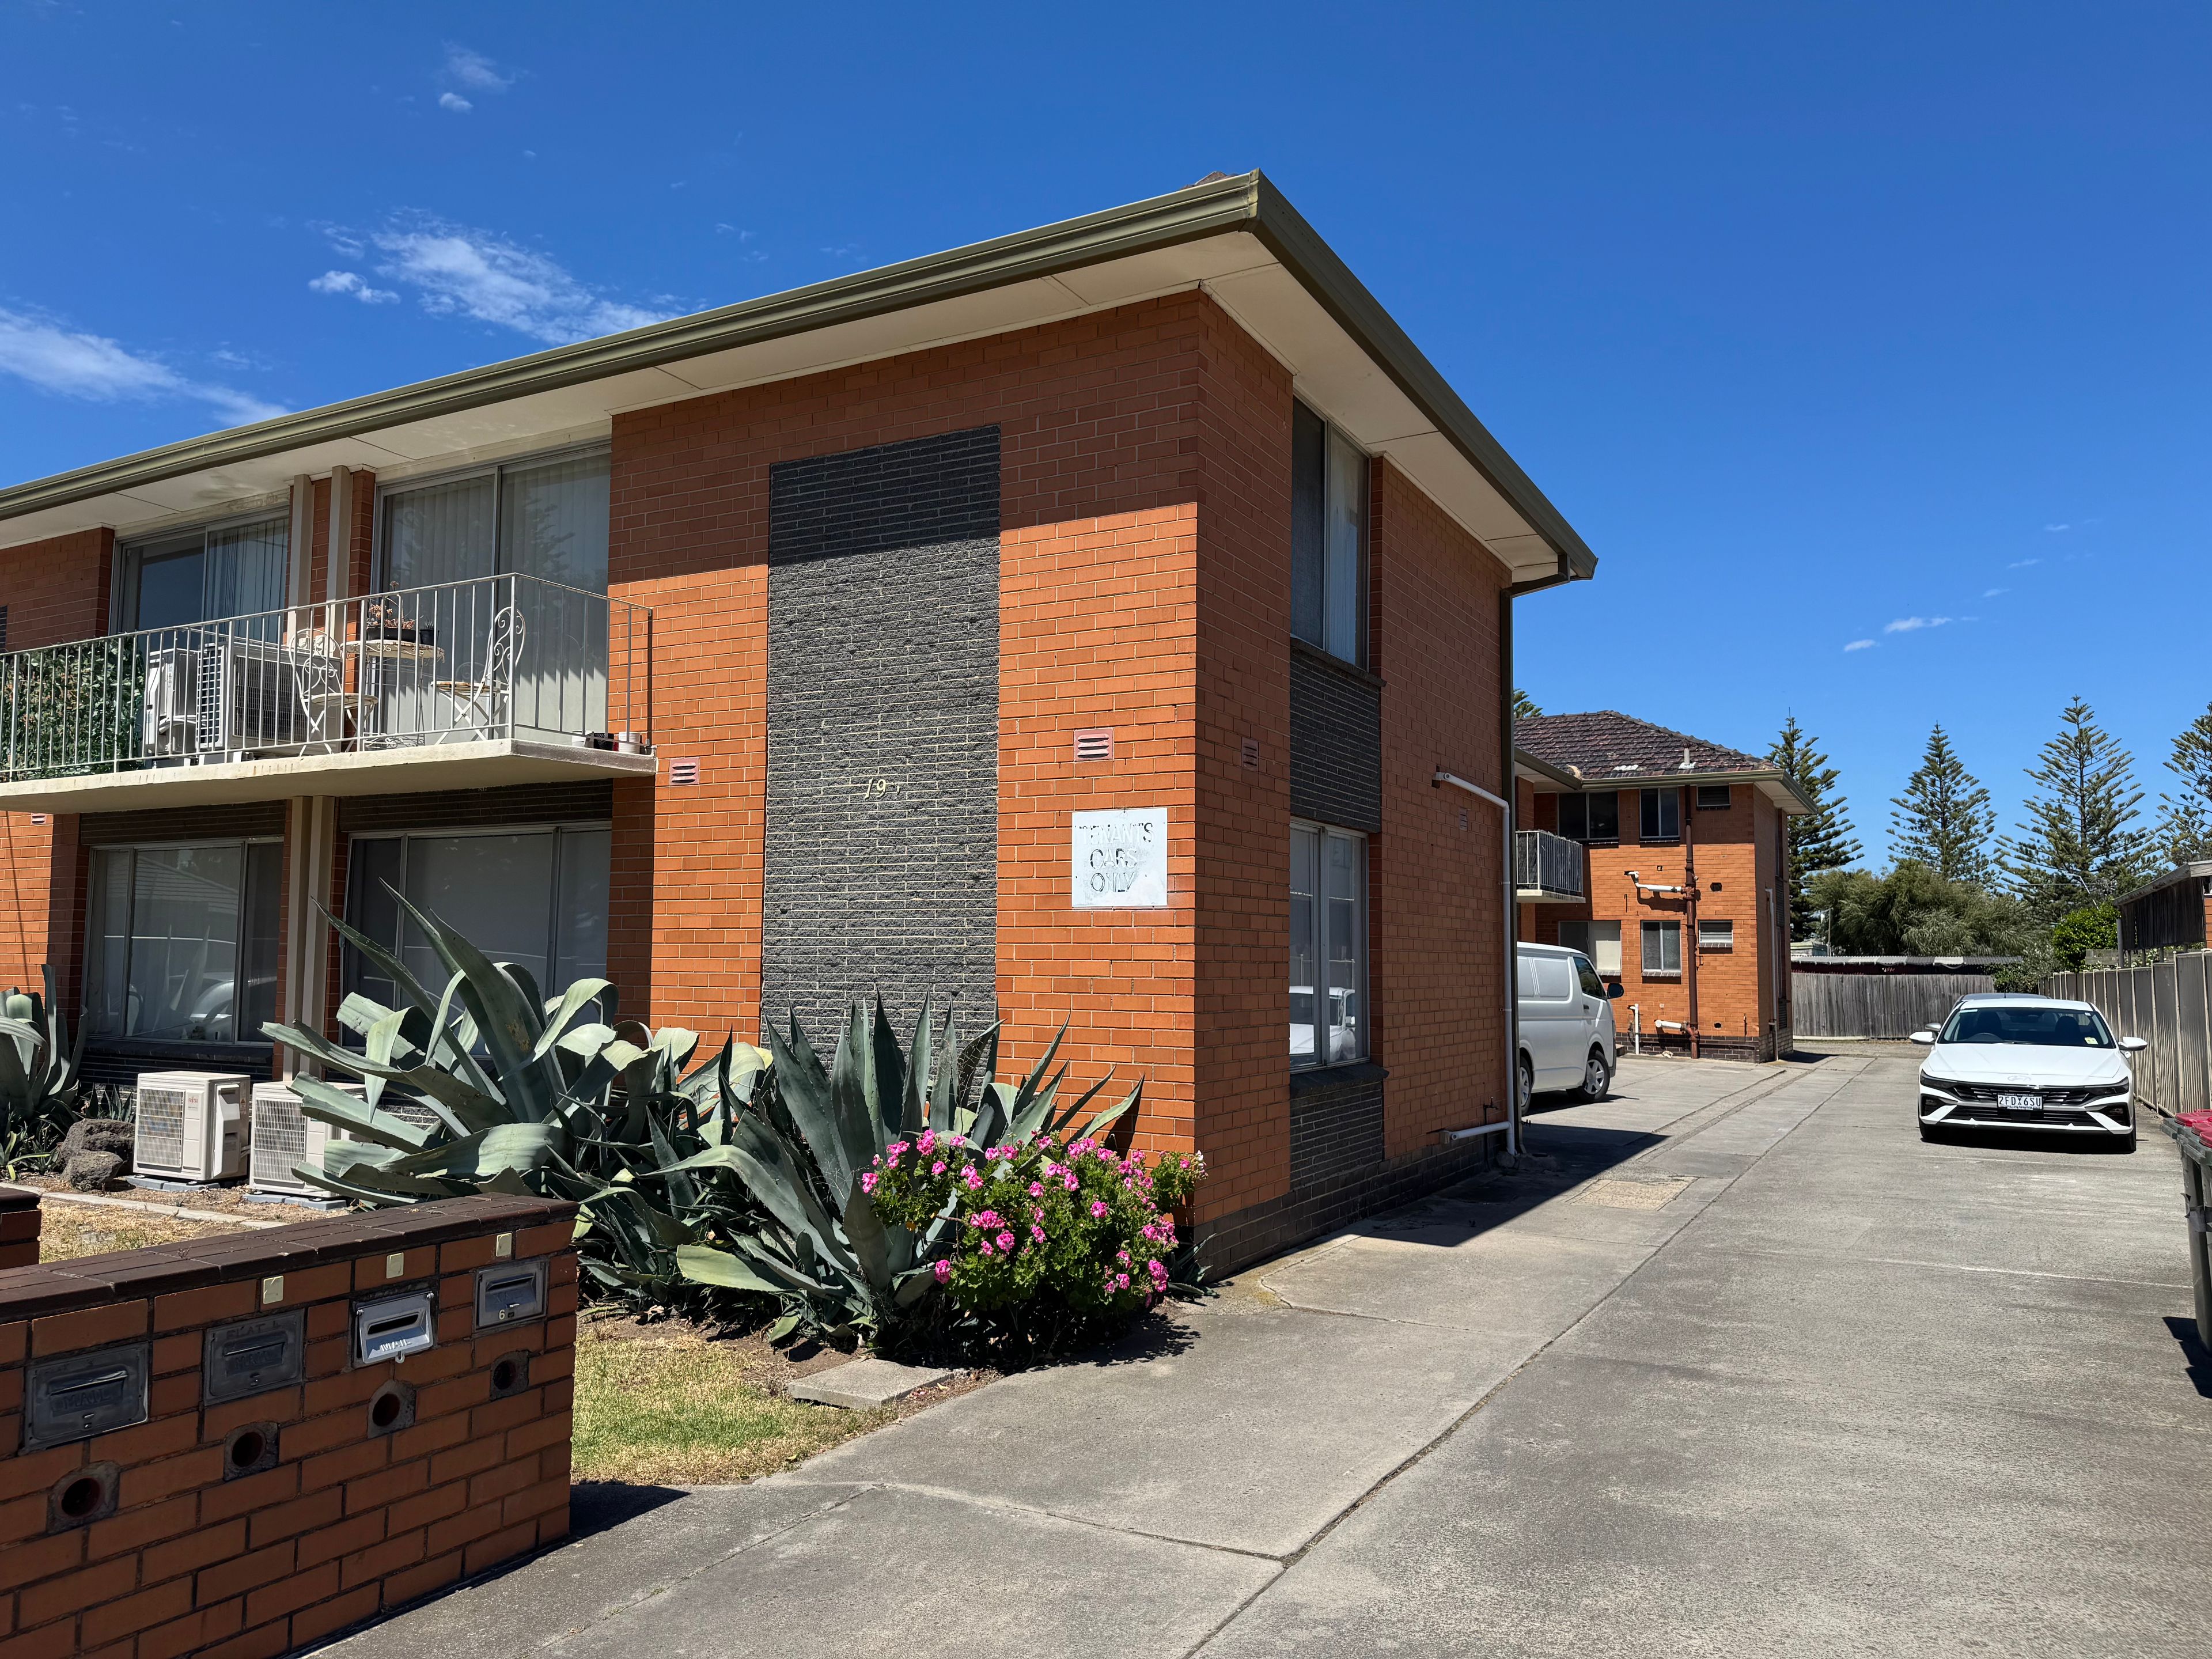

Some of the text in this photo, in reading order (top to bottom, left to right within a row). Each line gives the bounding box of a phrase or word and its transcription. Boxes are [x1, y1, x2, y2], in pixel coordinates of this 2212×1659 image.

[1090, 848, 1137, 869] CARS
[1090, 872, 1136, 892] ONLY
[499, 1309, 505, 1320] 6
[380, 1339, 412, 1351] MAIL
[63, 1388, 112, 1410] MAIL
